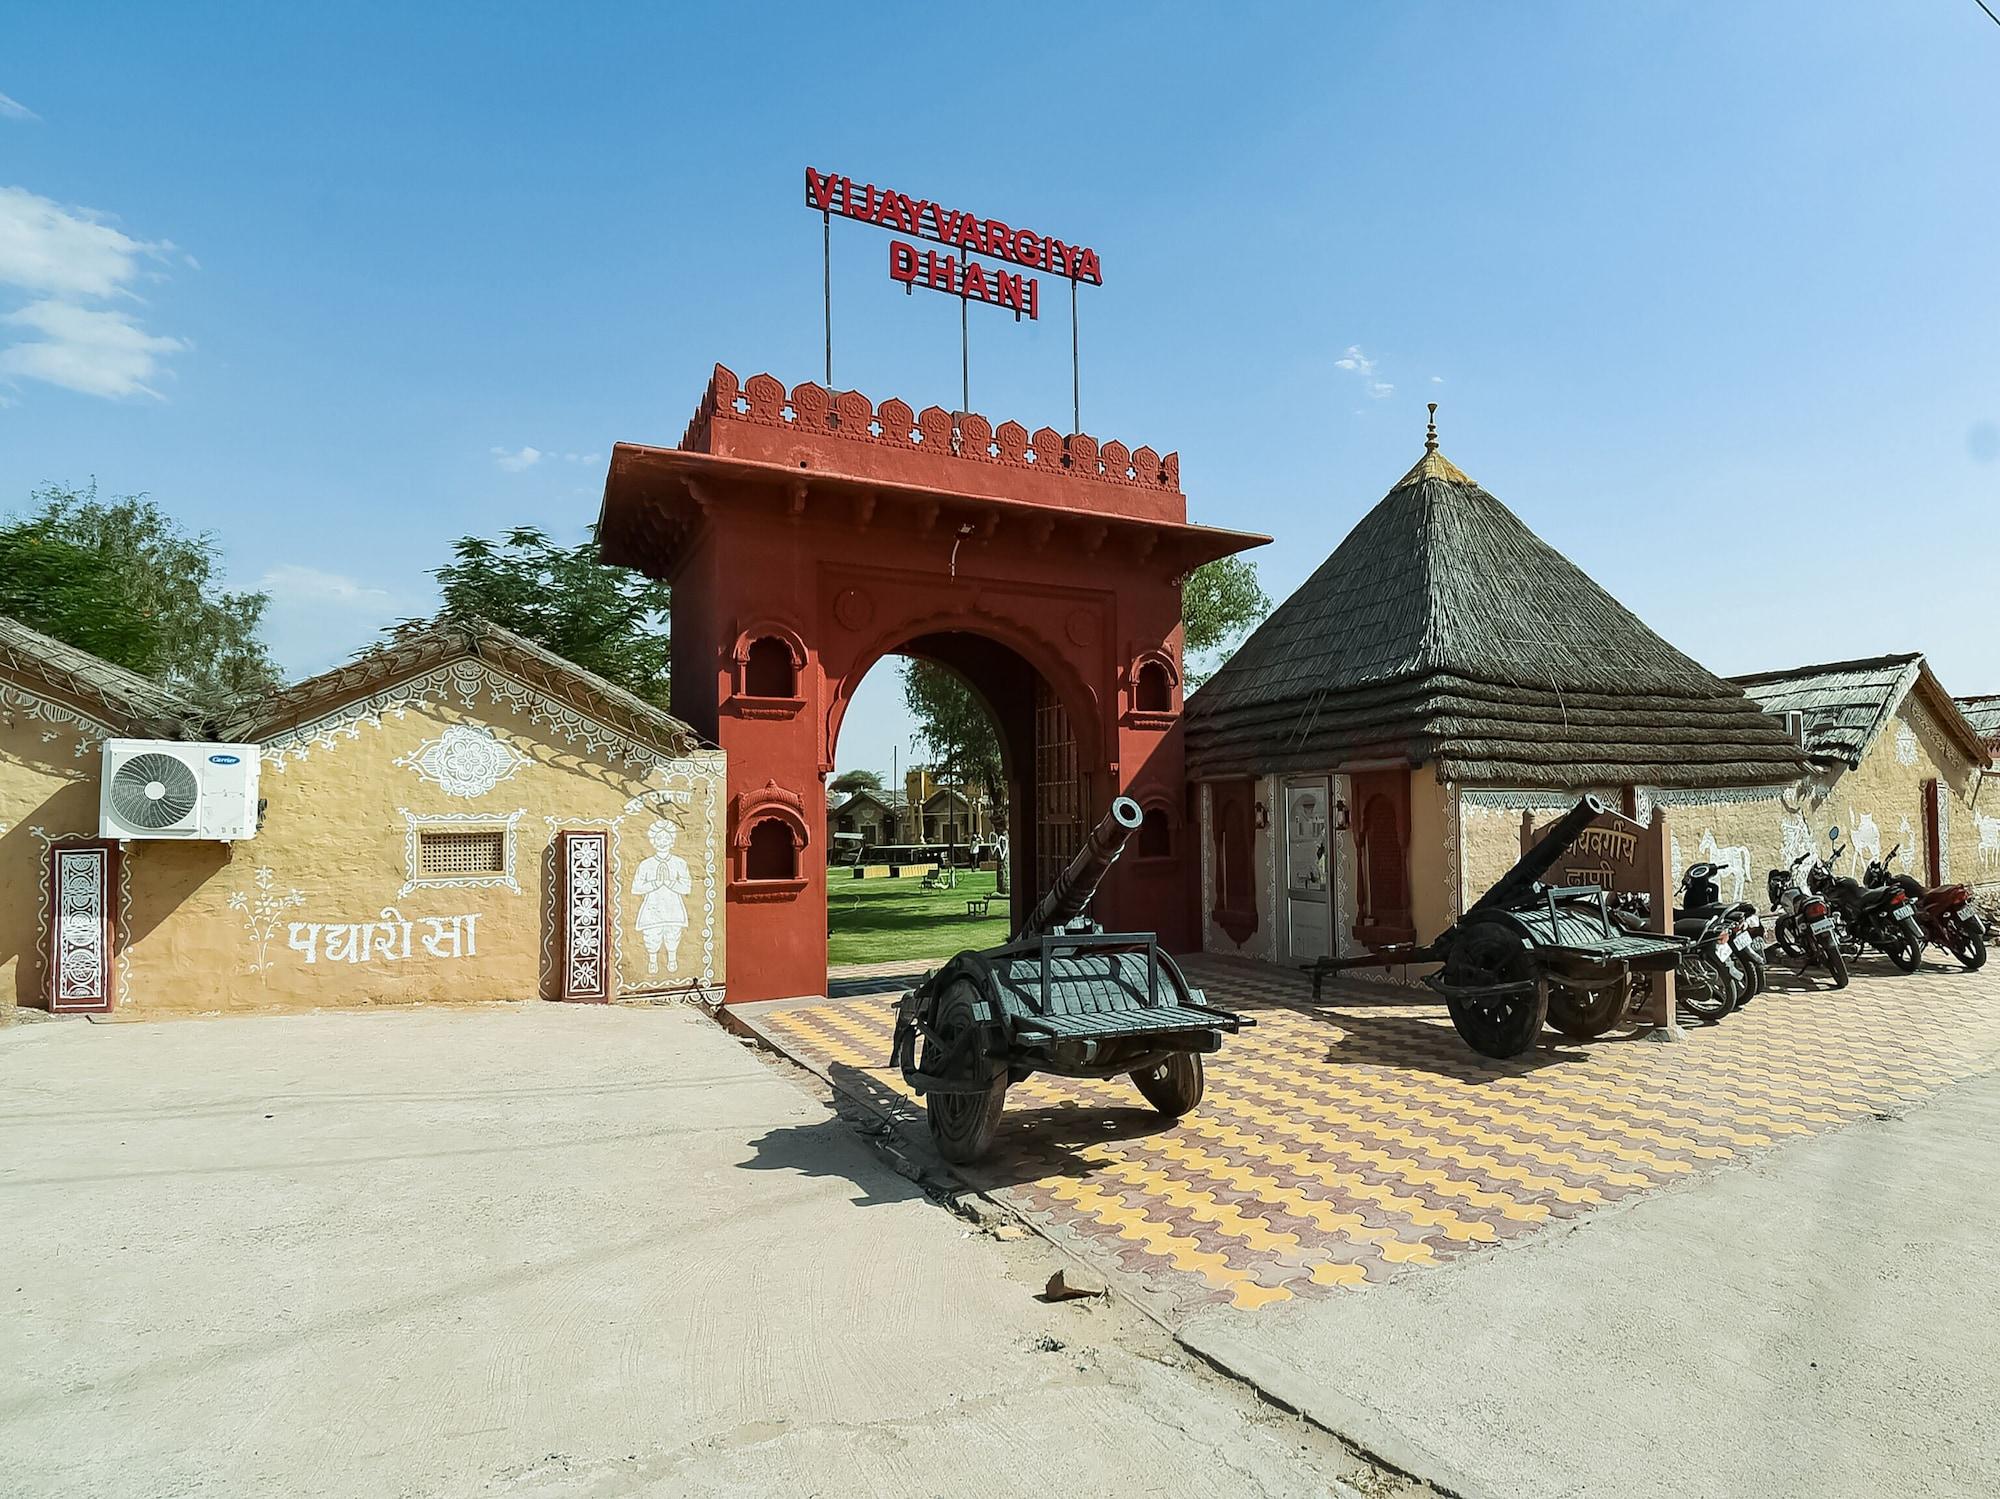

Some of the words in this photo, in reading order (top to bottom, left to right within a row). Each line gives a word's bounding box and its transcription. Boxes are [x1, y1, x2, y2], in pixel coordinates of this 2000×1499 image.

[806, 166, 1102, 285] VIJAYVARGIYA
[890, 240, 1038, 320] DHANI
[416, 912, 483, 958] सा
